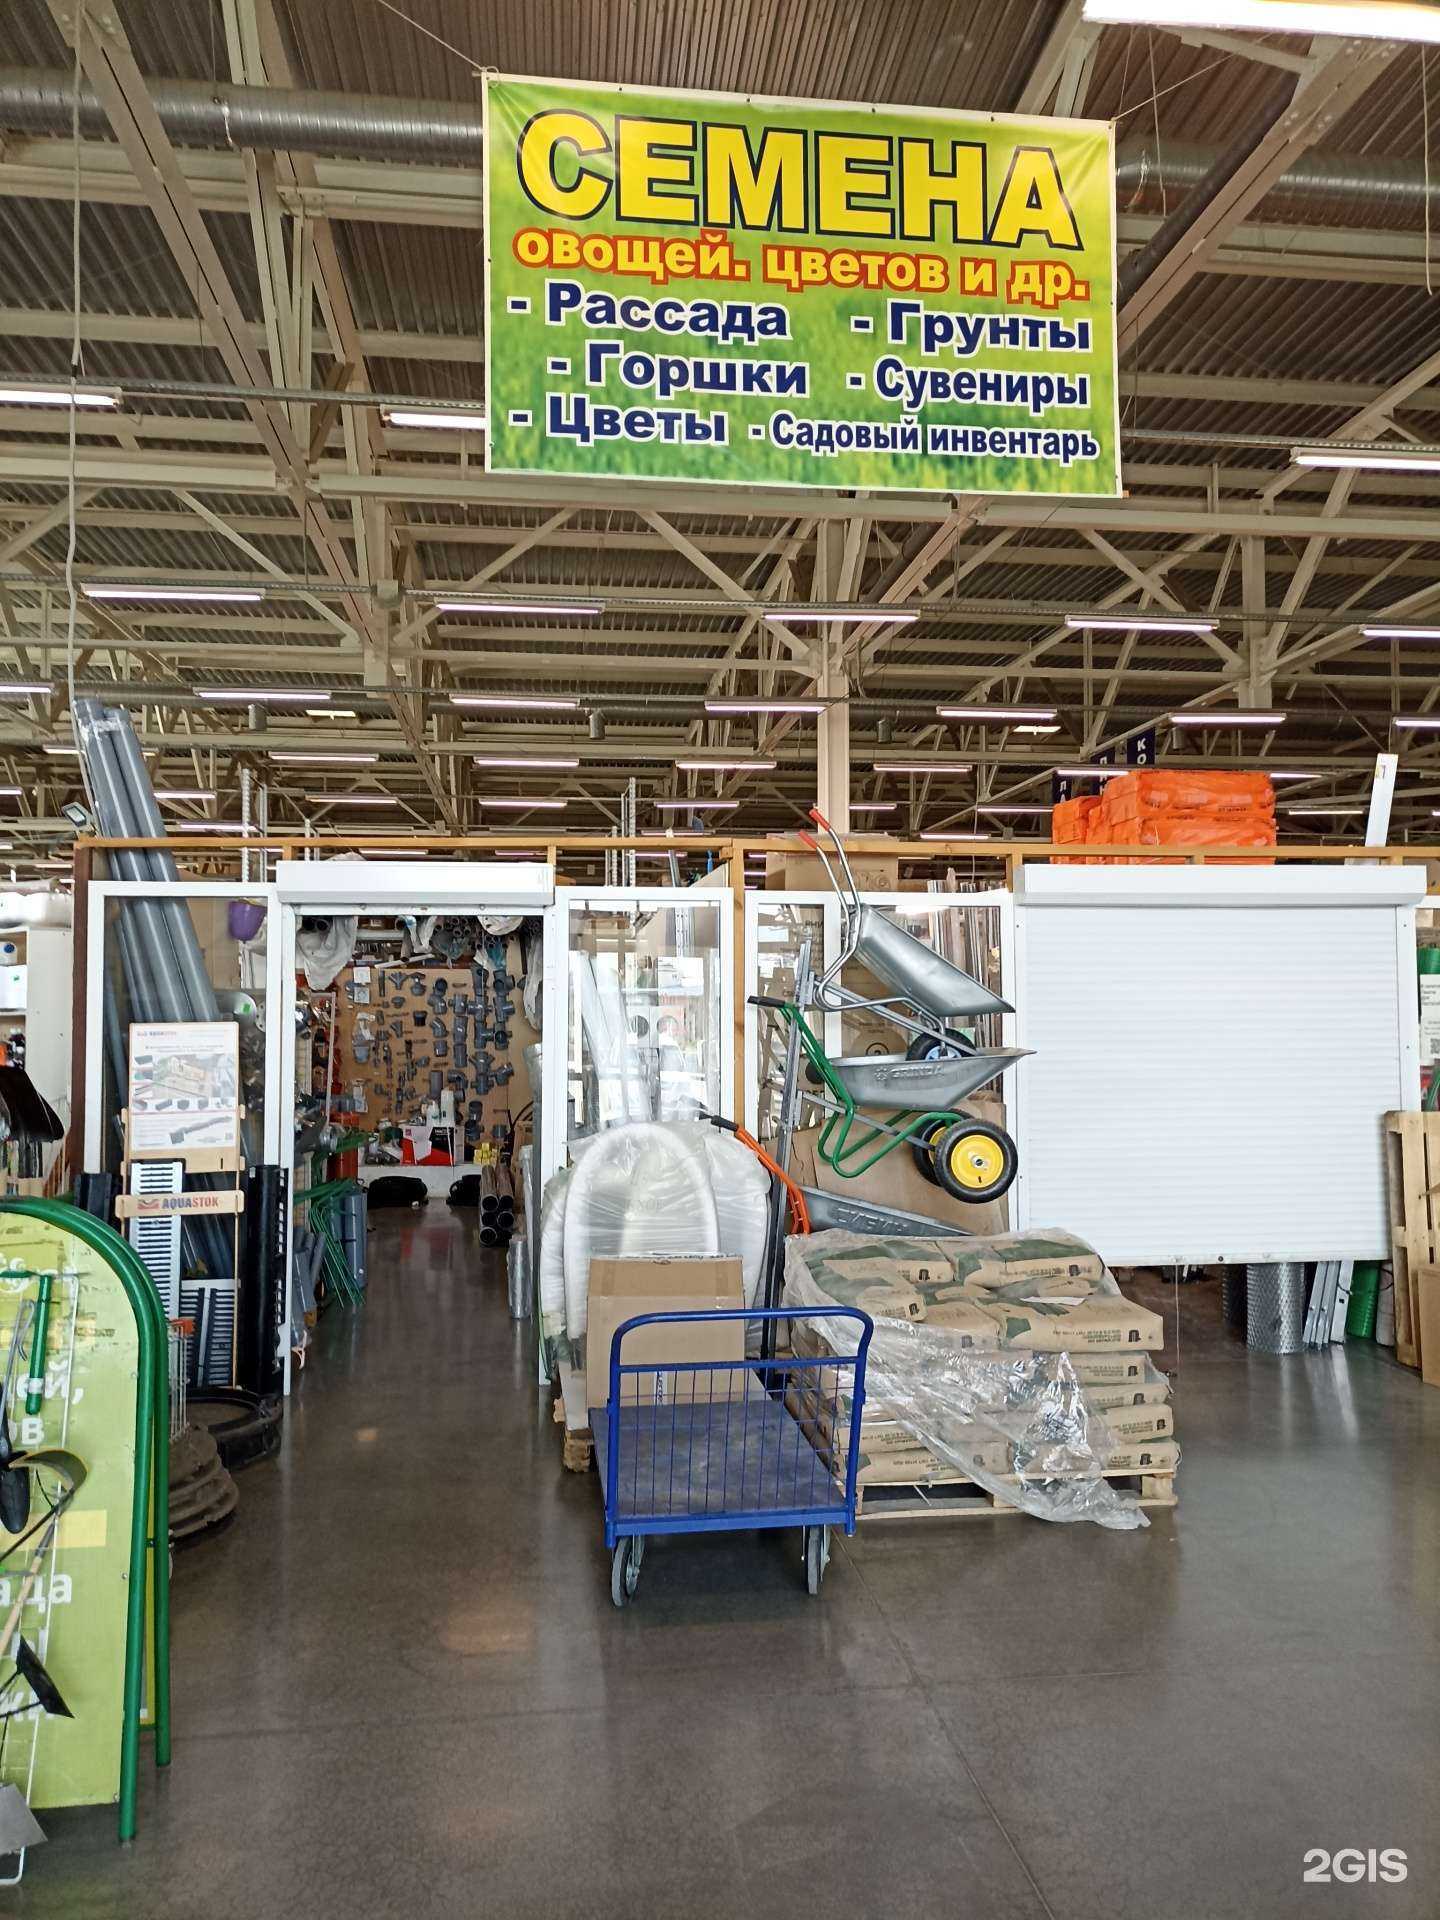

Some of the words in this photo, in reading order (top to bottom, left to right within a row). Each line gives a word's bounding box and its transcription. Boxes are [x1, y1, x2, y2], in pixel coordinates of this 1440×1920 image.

[517, 109, 1084, 250] СЕМЕНА
[514, 229, 750, 284] овощей.
[763, 245, 949, 291] цветов
[961, 259, 996, 294] и
[1008, 262, 1090, 307] др.
[548, 282, 787, 342] Рассада
[890, 301, 1090, 354] Грунты
[588, 342, 806, 396] Горшки
[875, 357, 1088, 412] Сувениры
[549, 395, 726, 443] Цветы
[772, 413, 919, 454] Садовый
[929, 428, 1098, 464] инвентарь
[161, 1195, 219, 1210] AQUASTOK
